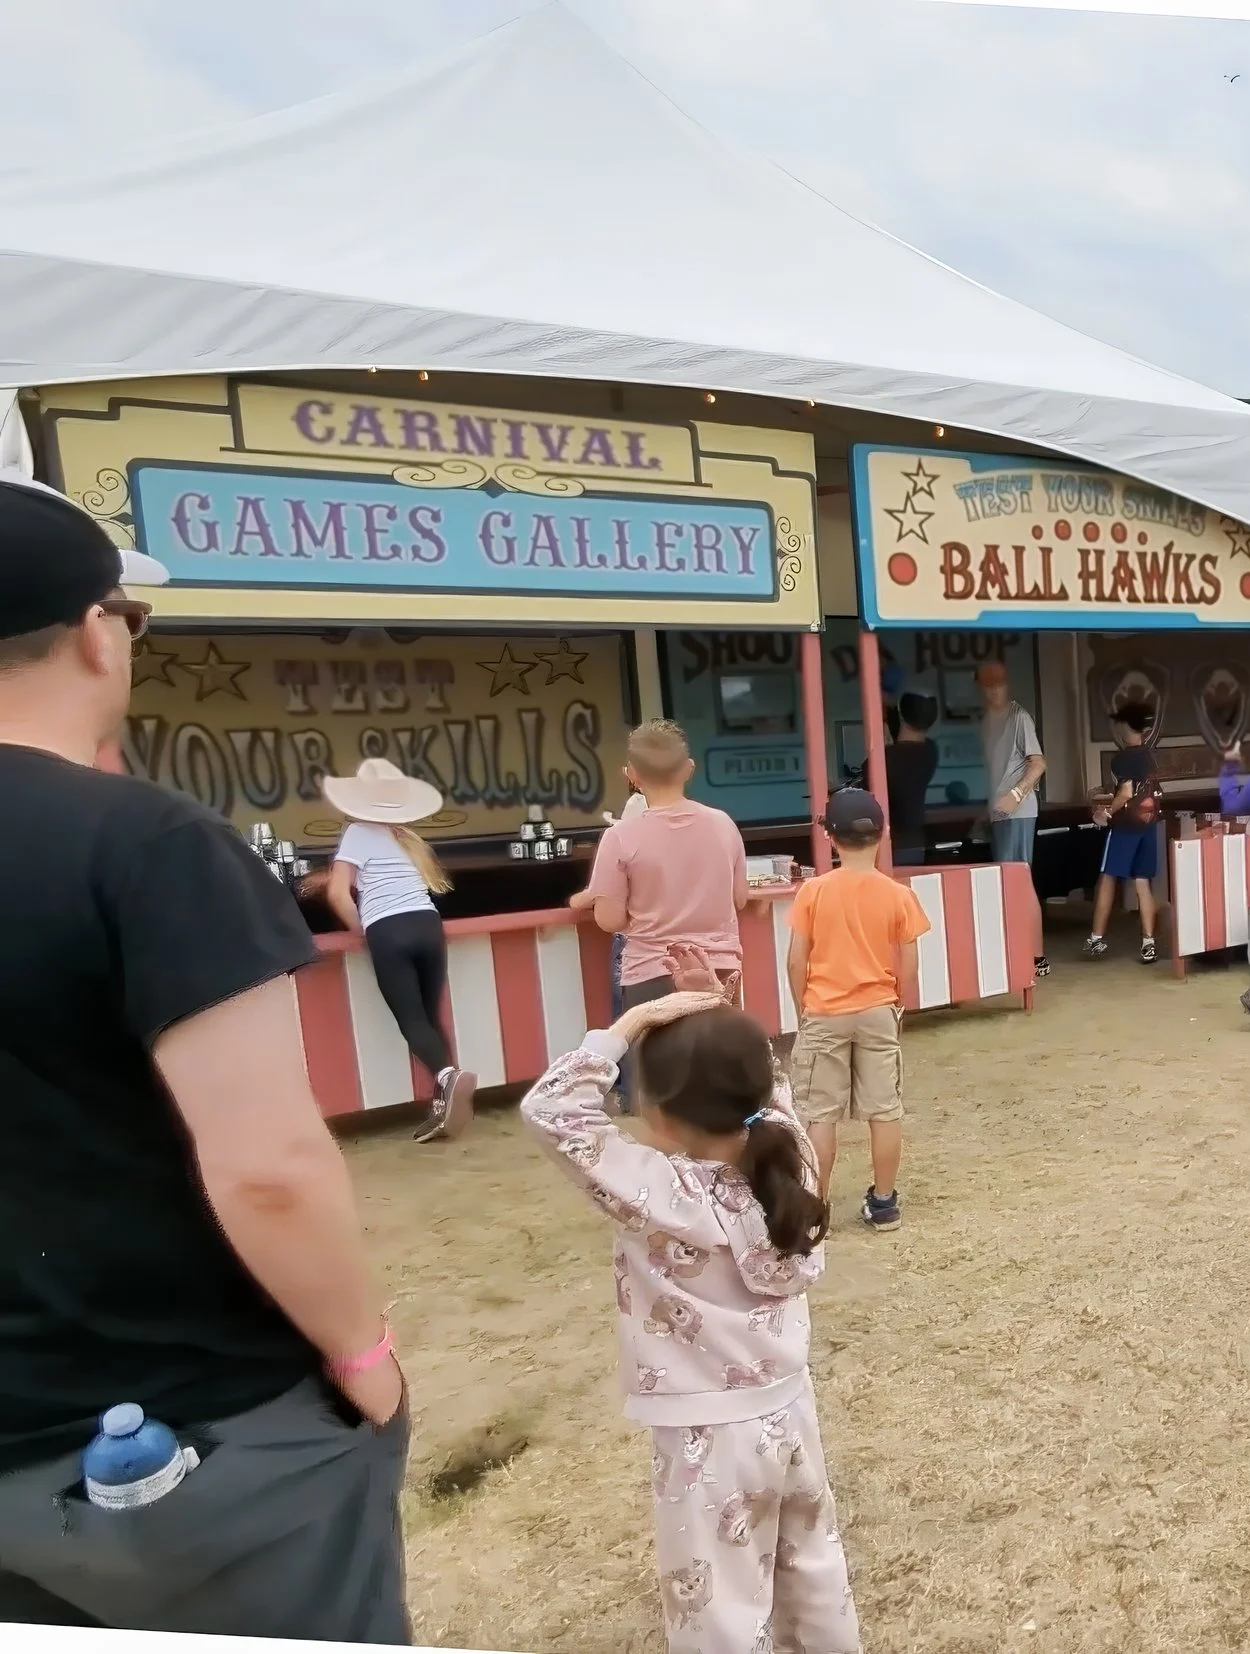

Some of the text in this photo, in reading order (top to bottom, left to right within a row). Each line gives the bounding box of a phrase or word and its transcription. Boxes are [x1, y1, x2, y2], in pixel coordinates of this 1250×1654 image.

[291, 400, 663, 471] CARNIVAL
[953, 474, 1033, 522] TEST
[1040, 474, 1115, 517] YOUR
[171, 492, 761, 575] GAMES GALLERY
[940, 540, 1221, 605] BALL HAWKS
[274, 658, 456, 715] TEST
